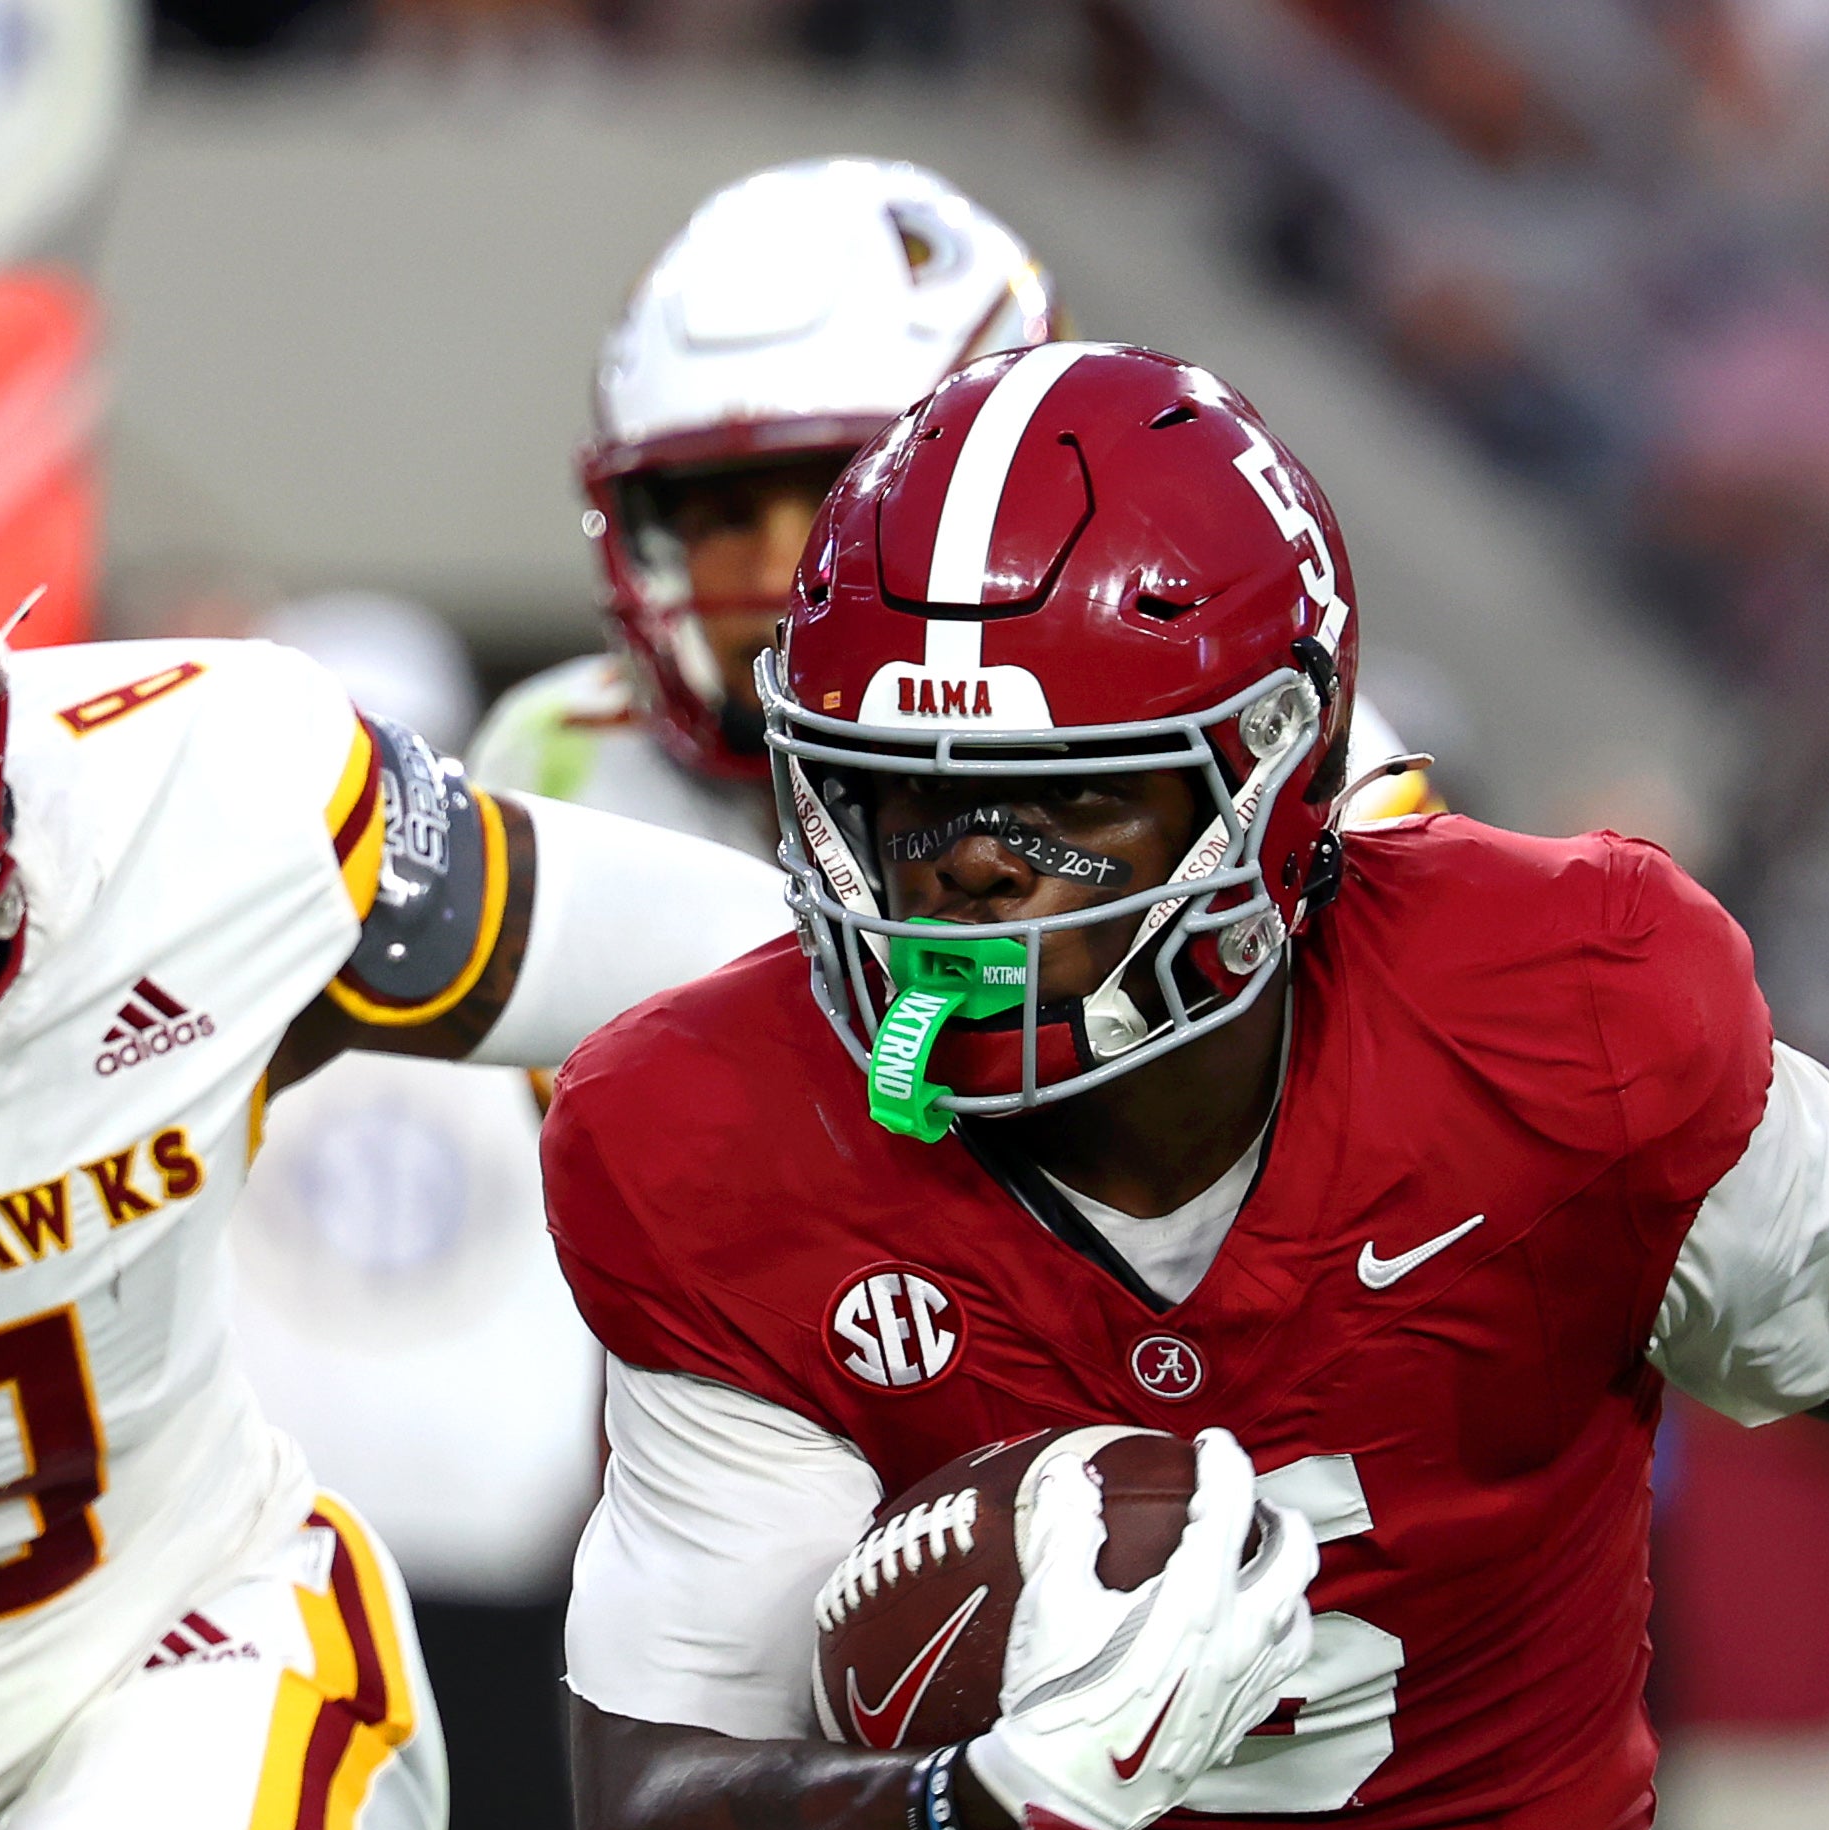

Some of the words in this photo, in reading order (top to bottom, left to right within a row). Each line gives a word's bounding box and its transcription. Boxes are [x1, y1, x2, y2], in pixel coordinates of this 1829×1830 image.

[52, 661, 208, 740] 8
[897, 677, 993, 715] BAMA
[823, 848, 862, 901] TIDE
[95, 1013, 215, 1076] adidas
[874, 990, 949, 1101] NXTRND
[832, 1271, 959, 1387] SEC
